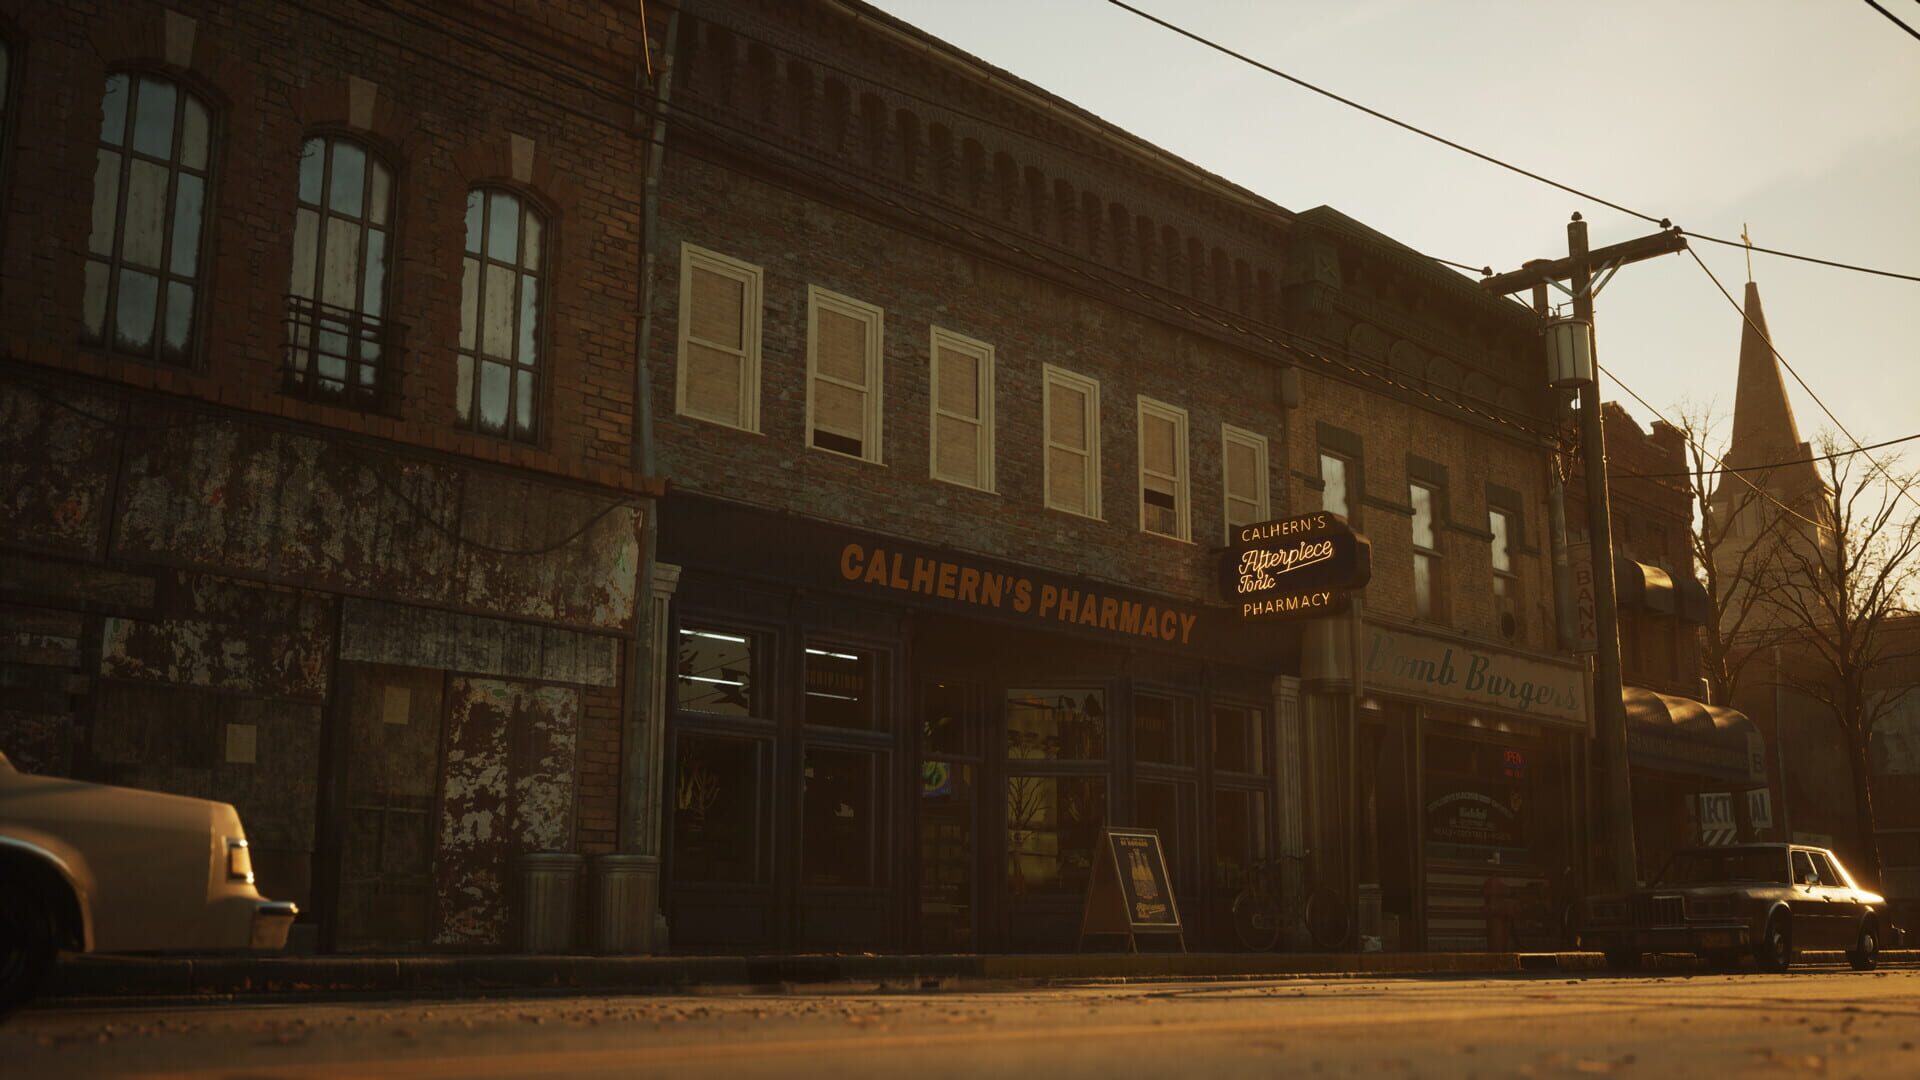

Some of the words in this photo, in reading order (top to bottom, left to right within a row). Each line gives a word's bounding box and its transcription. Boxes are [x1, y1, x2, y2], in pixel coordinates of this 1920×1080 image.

[1241, 515, 1327, 542] CALHERN'S
[1238, 540, 1334, 579] Afterpiece
[840, 543, 1033, 613] CALHERN'S
[1039, 584, 1197, 644] PHARMACY
[1237, 573, 1277, 594] Tonic
[1242, 592, 1331, 617] PHARMACY
[1576, 570, 1596, 640] BANK
[1365, 632, 1457, 686] Bomb
[1464, 653, 1580, 711] Burgers
